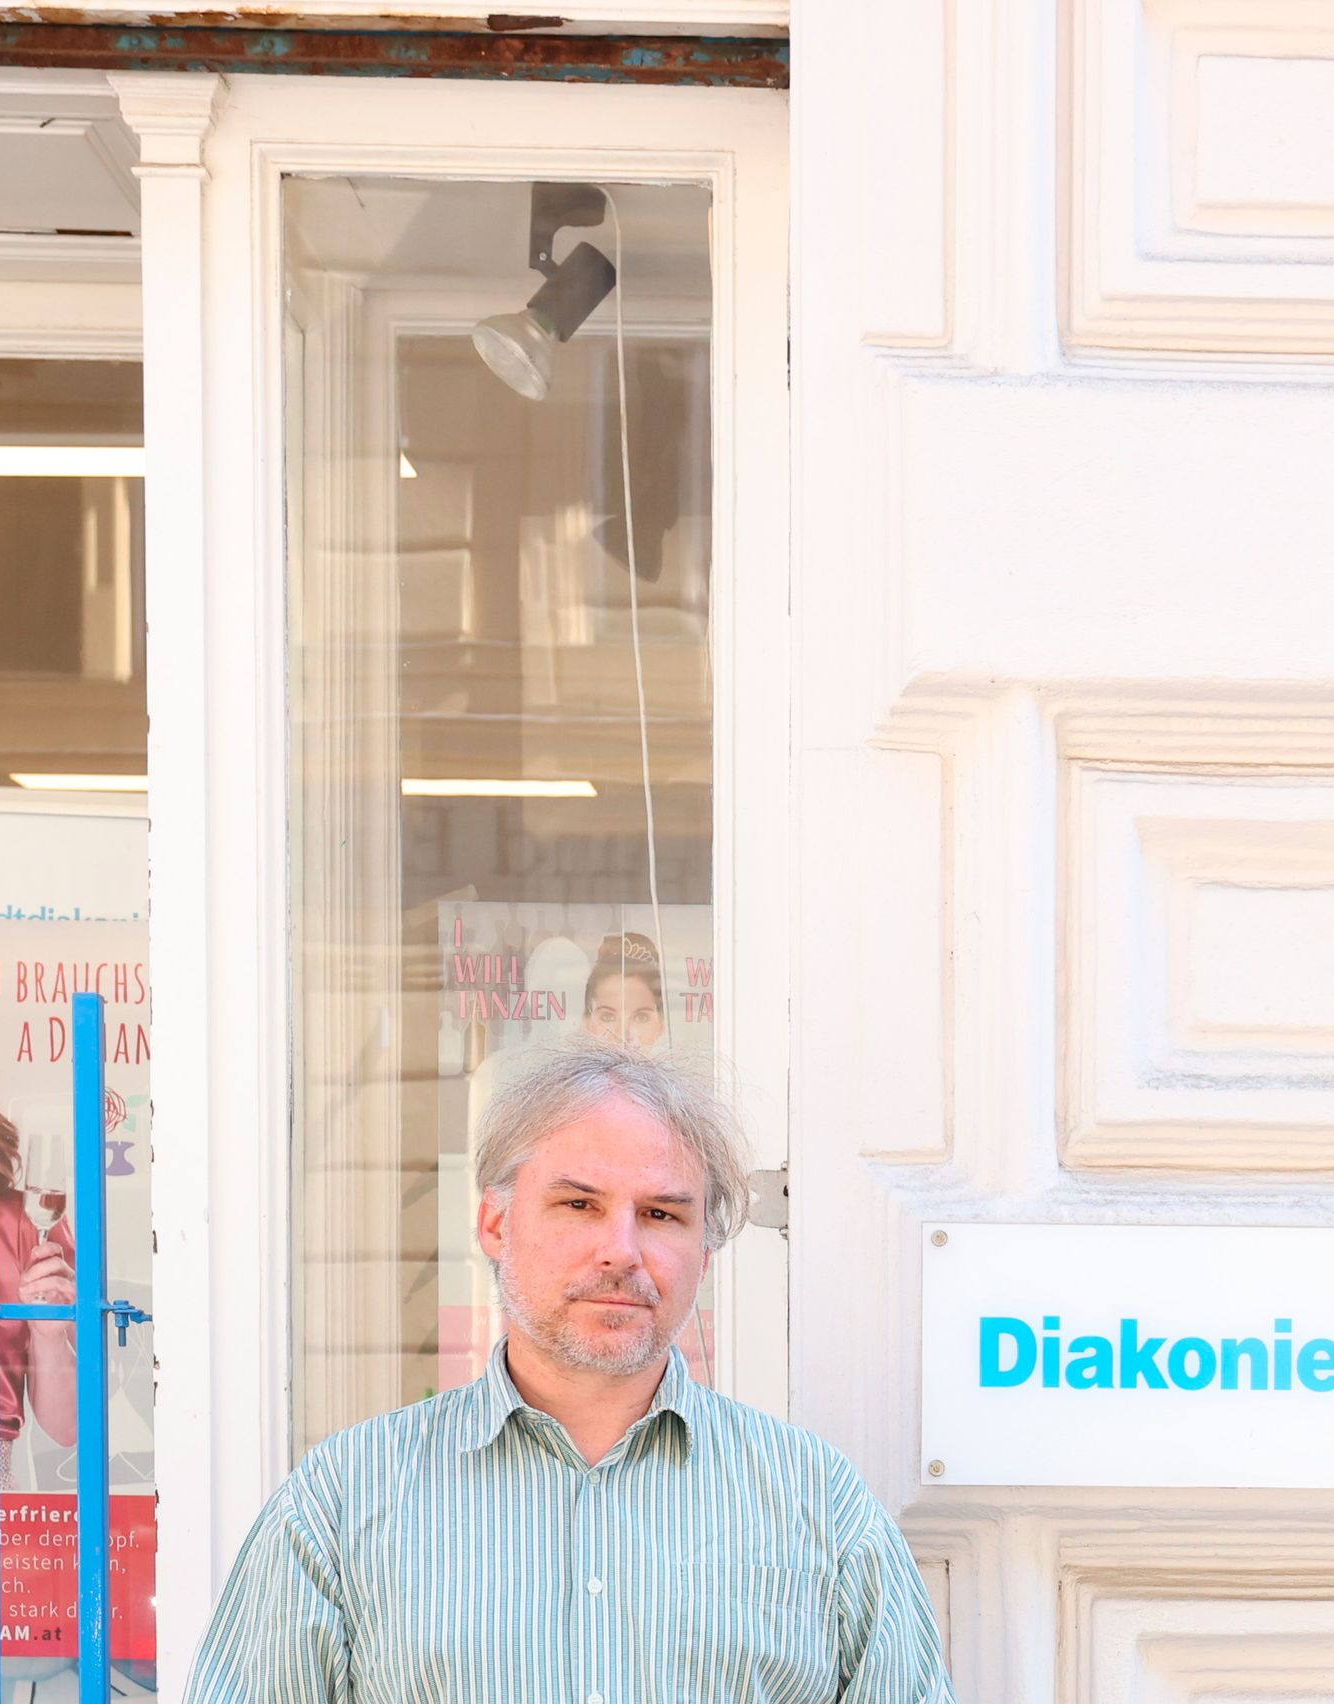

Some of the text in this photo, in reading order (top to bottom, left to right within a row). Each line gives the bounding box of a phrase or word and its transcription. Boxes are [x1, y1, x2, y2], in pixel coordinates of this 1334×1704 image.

[455, 917, 463, 949] I
[454, 953, 524, 985] WILL
[454, 988, 567, 1021] TANZEN
[17, 1021, 33, 1063] A
[0, 1530, 31, 1547] ber
[3, 1554, 64, 1572] eisten
[9, 1602, 59, 1619] stark
